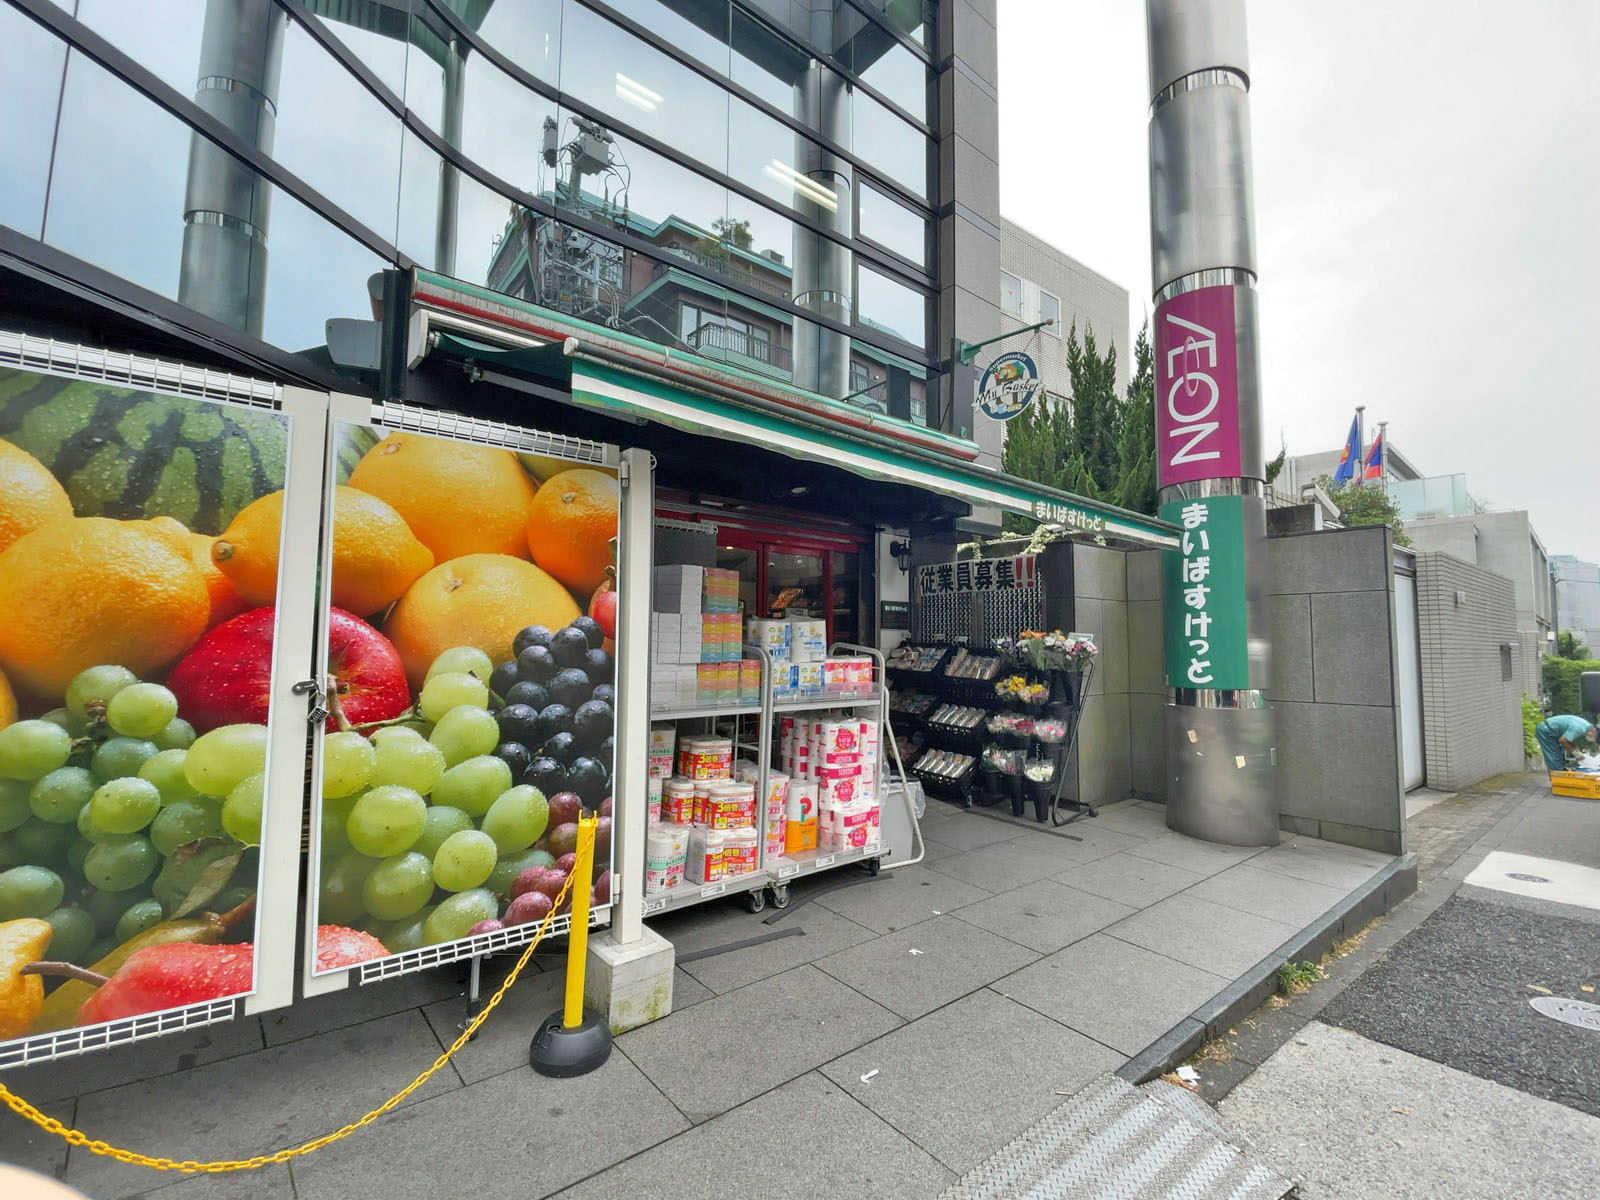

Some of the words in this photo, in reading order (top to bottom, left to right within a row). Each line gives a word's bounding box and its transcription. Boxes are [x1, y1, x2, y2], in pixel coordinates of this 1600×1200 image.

[975, 388, 997, 403] My
[1002, 379, 1039, 394] Basket
[1035, 501, 1102, 532] まいばすけっと
[1180, 502, 1213, 685] まいばすけっと
